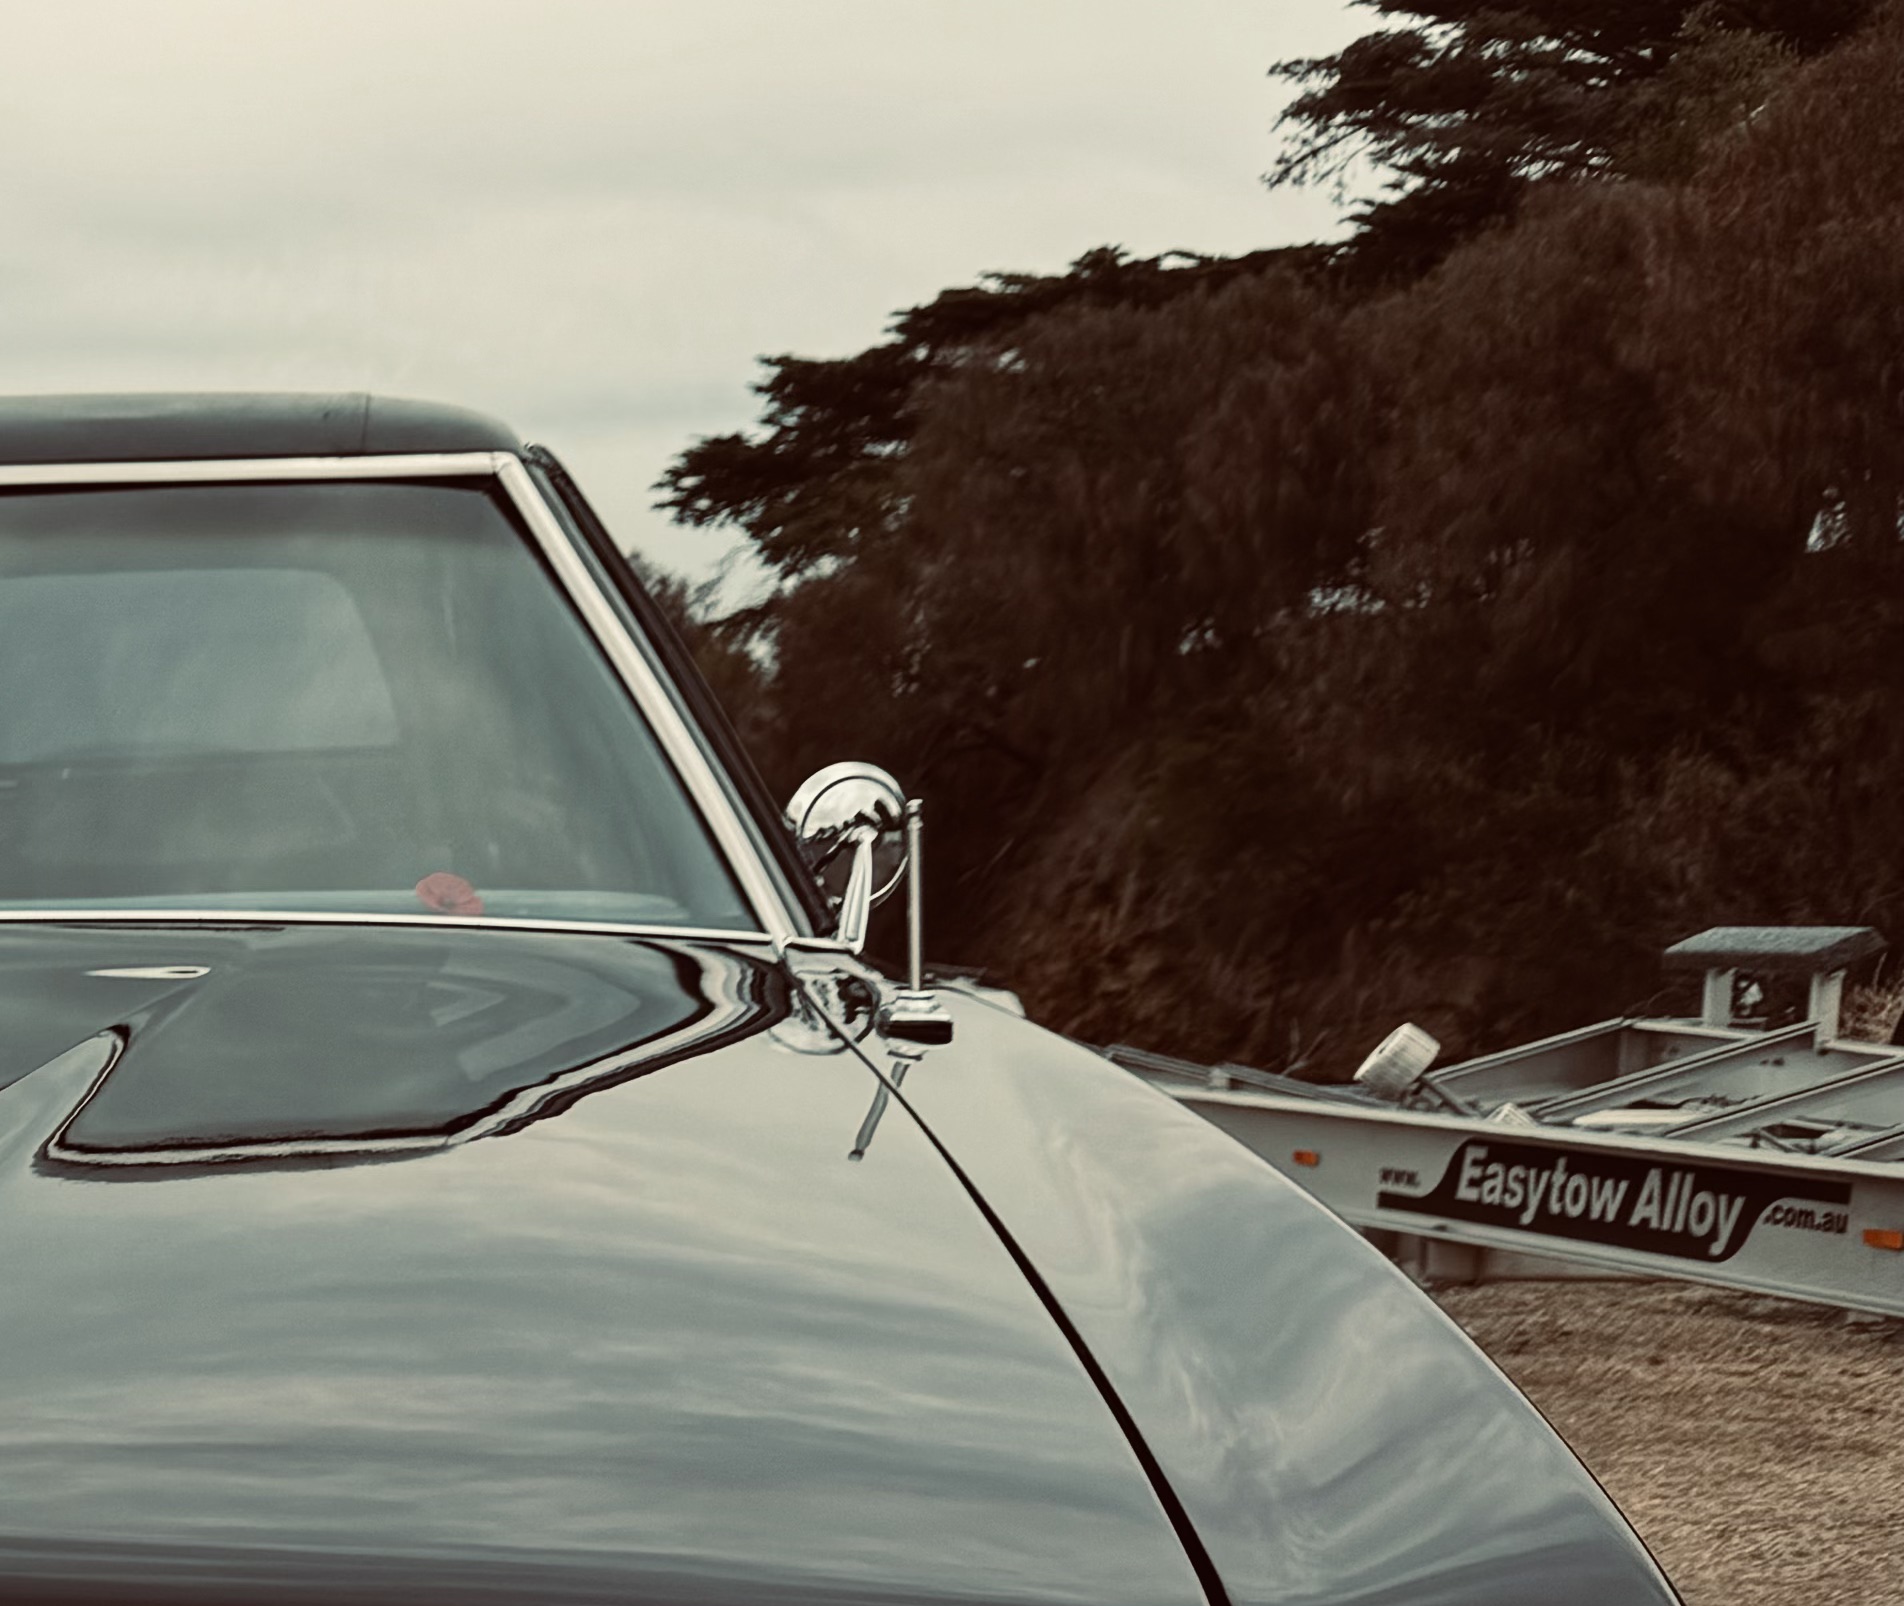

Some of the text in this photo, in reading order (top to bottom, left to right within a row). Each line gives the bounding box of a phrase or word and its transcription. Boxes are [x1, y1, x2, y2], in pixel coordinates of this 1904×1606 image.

[1454, 1145, 1746, 1257] Easytow Alloy
[1762, 1203, 1849, 1234] .com.au
